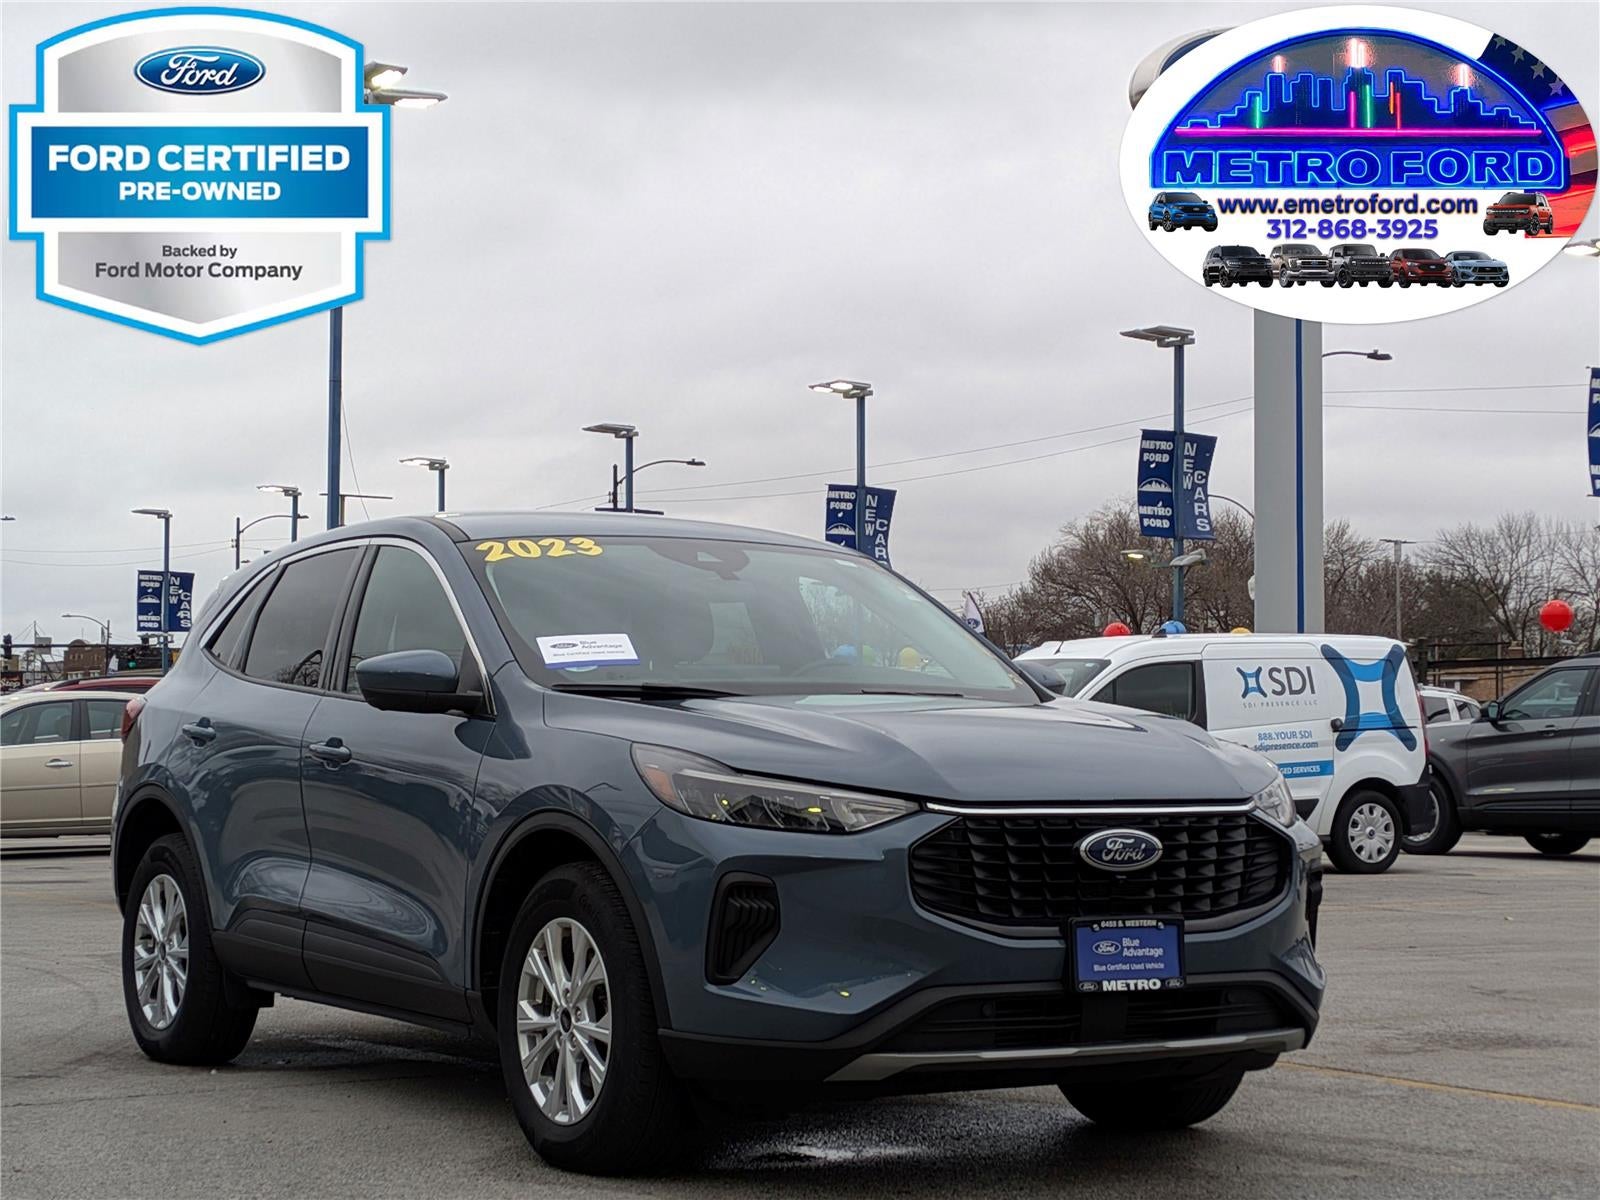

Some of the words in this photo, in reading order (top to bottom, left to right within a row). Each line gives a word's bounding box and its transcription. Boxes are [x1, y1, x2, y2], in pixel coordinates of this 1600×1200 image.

[1142, 440, 1173, 450] METRO
[1143, 453, 1170, 462] FORD
[1183, 442, 1197, 490] NEW
[830, 501, 853, 510] FORD
[1194, 471, 1210, 531] CARS
[865, 495, 878, 536] NEW
[1139, 506, 1172, 516] METRO
[1143, 518, 1170, 528] FORD
[875, 519, 888, 564] CAR
[475, 537, 604, 563] 2023
[169, 577, 180, 604] NEW
[180, 592, 191, 627] CARS
[1268, 666, 1316, 696] SDI
[1258, 731, 1297, 741] 888.YOUR
[1299, 730, 1313, 739] SDI
[1293, 765, 1321, 773] SERVICES
[1102, 837, 1145, 861] Ford
[1098, 943, 1116, 953] Ford
[1122, 938, 1140, 947] Blue
[1123, 947, 1164, 957] Advantage
[1102, 979, 1161, 991] METRO
